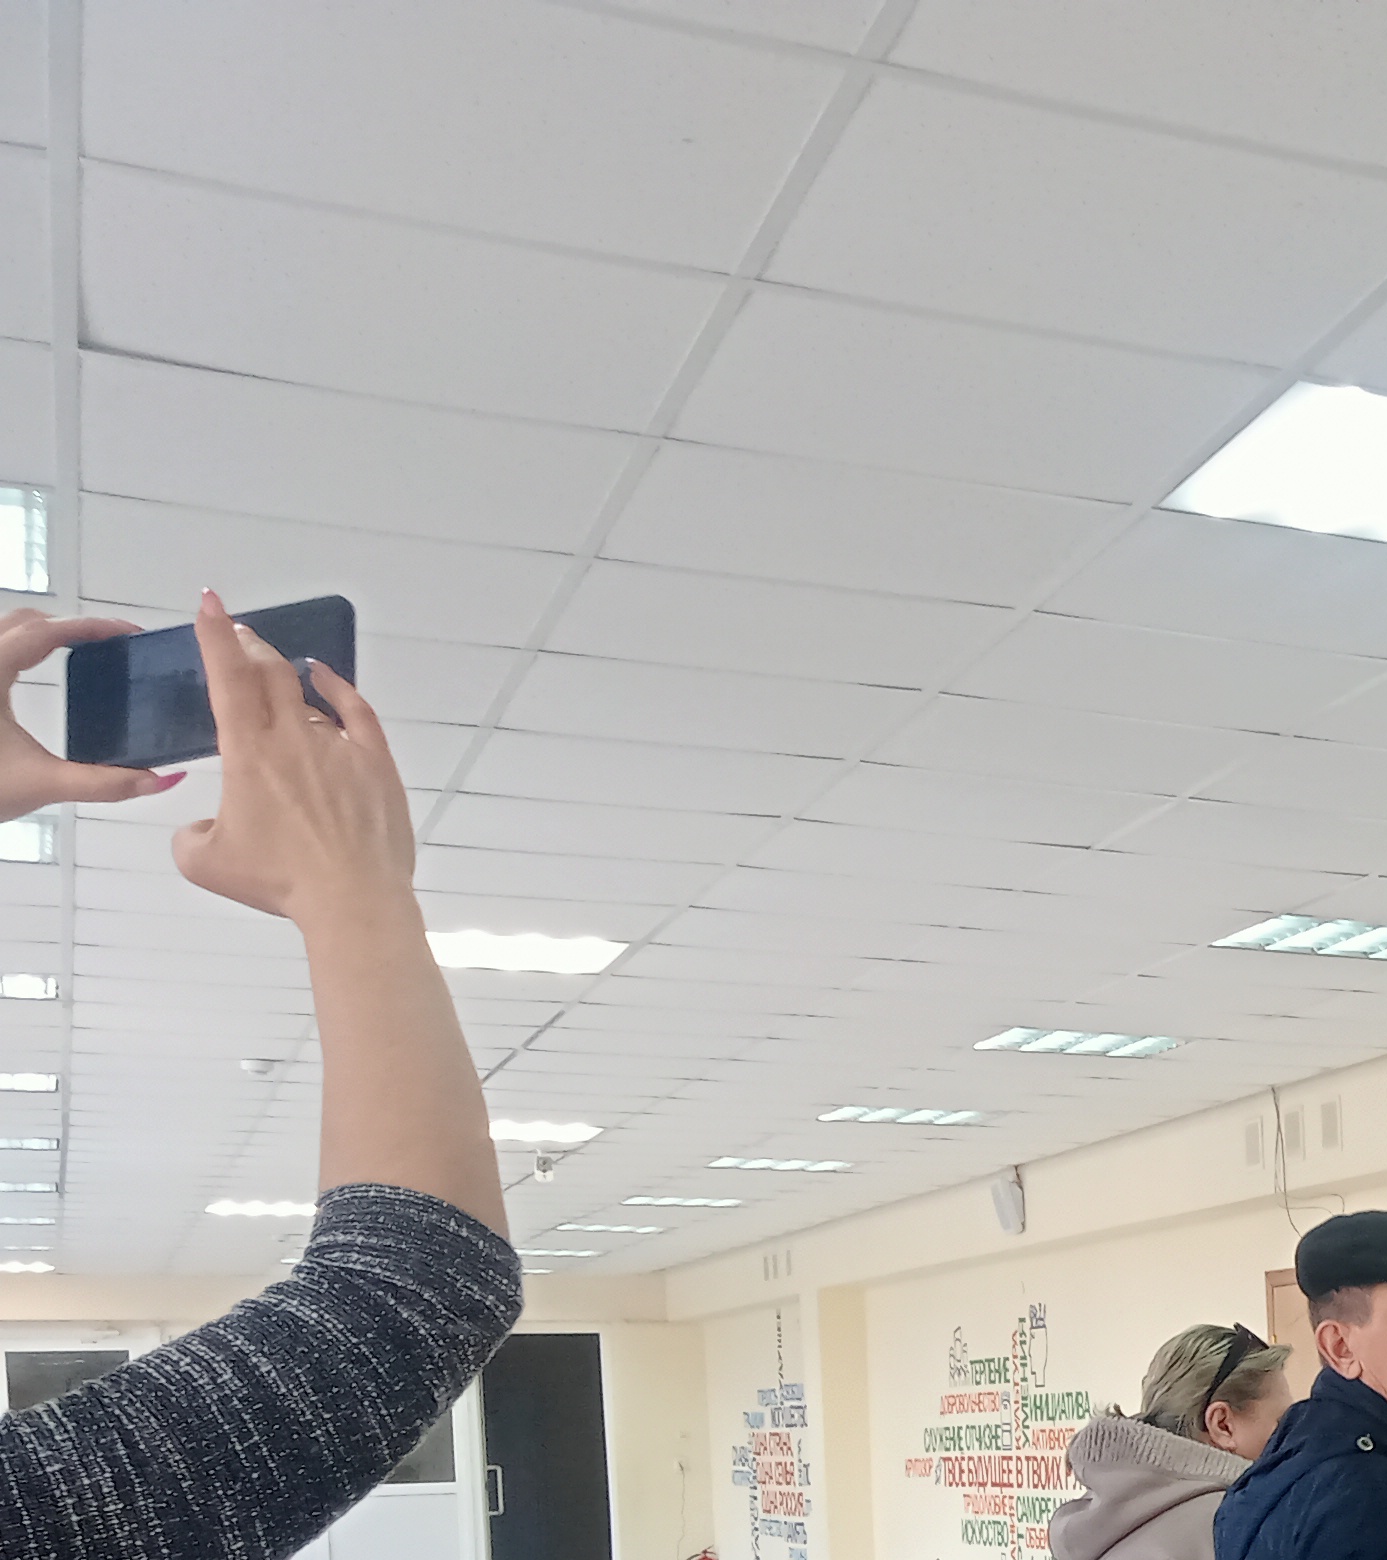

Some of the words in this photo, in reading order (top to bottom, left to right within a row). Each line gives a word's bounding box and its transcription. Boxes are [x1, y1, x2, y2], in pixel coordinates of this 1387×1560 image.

[1030, 1391, 1091, 1427] ИНИЦИАТИВА
[967, 1455, 1014, 1494] БУДУЩЕЕ
[1016, 1456, 1024, 1489] В
[1024, 1456, 1063, 1490] ТВОИХ
